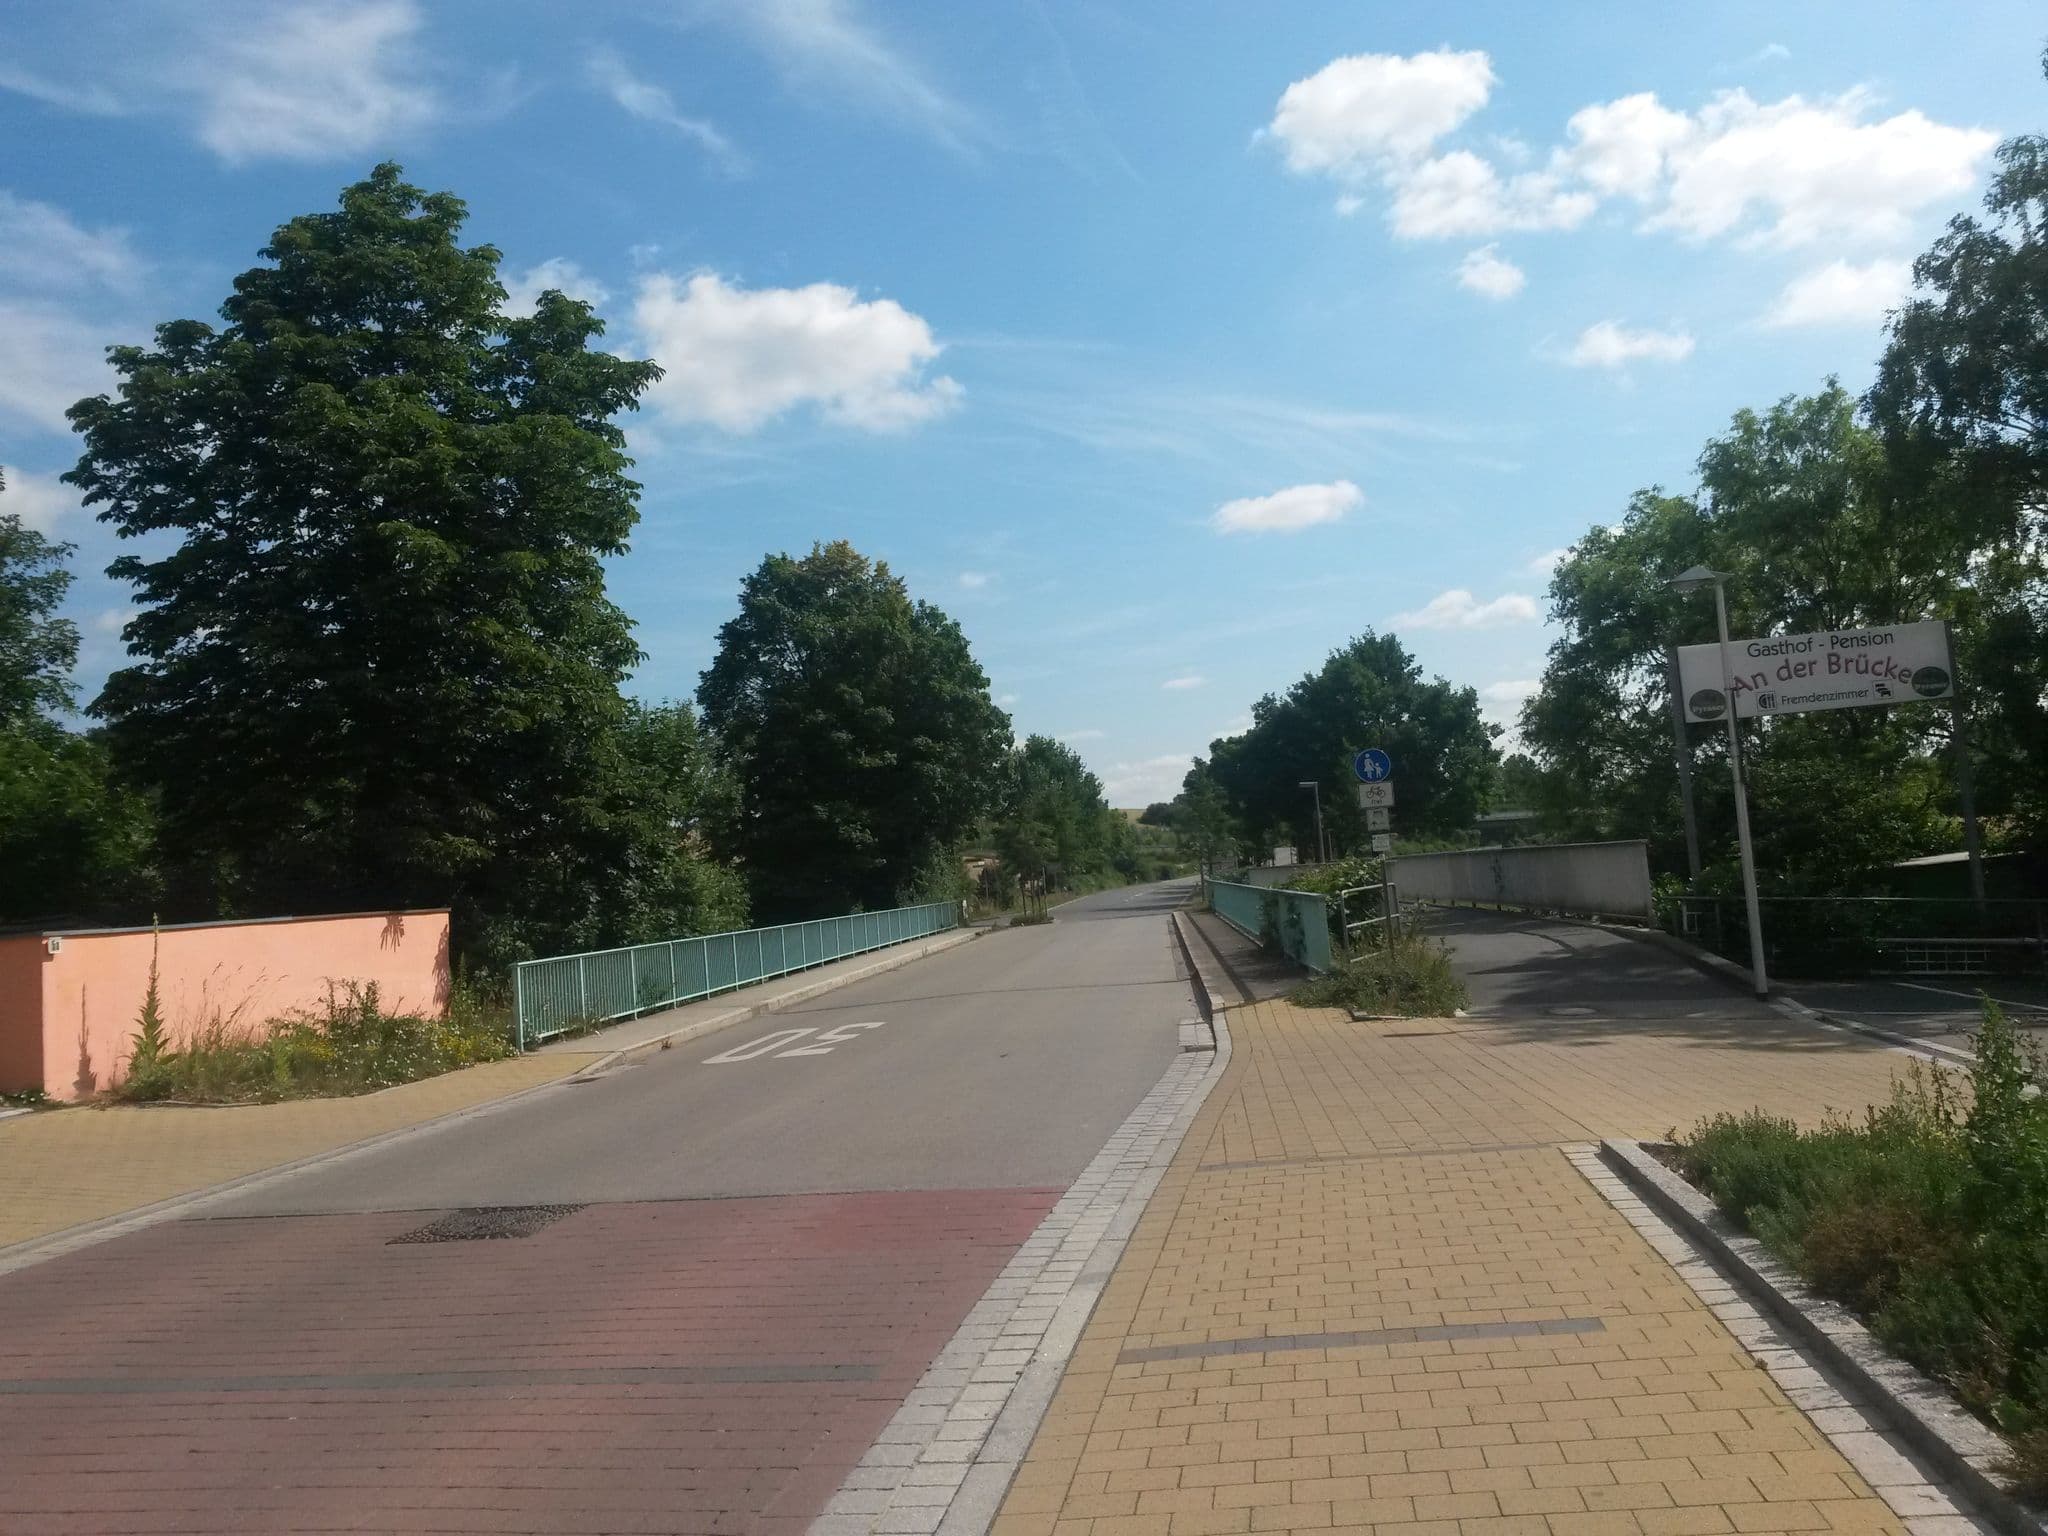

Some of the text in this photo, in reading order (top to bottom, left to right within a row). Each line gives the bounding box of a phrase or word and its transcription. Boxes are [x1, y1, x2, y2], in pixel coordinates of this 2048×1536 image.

[1747, 638, 1813, 658] Gasthof
[1830, 632, 1894, 650] Pension
[1733, 652, 1912, 697] An der Brücke
[1781, 688, 1869, 706] Fremdenzimmer
